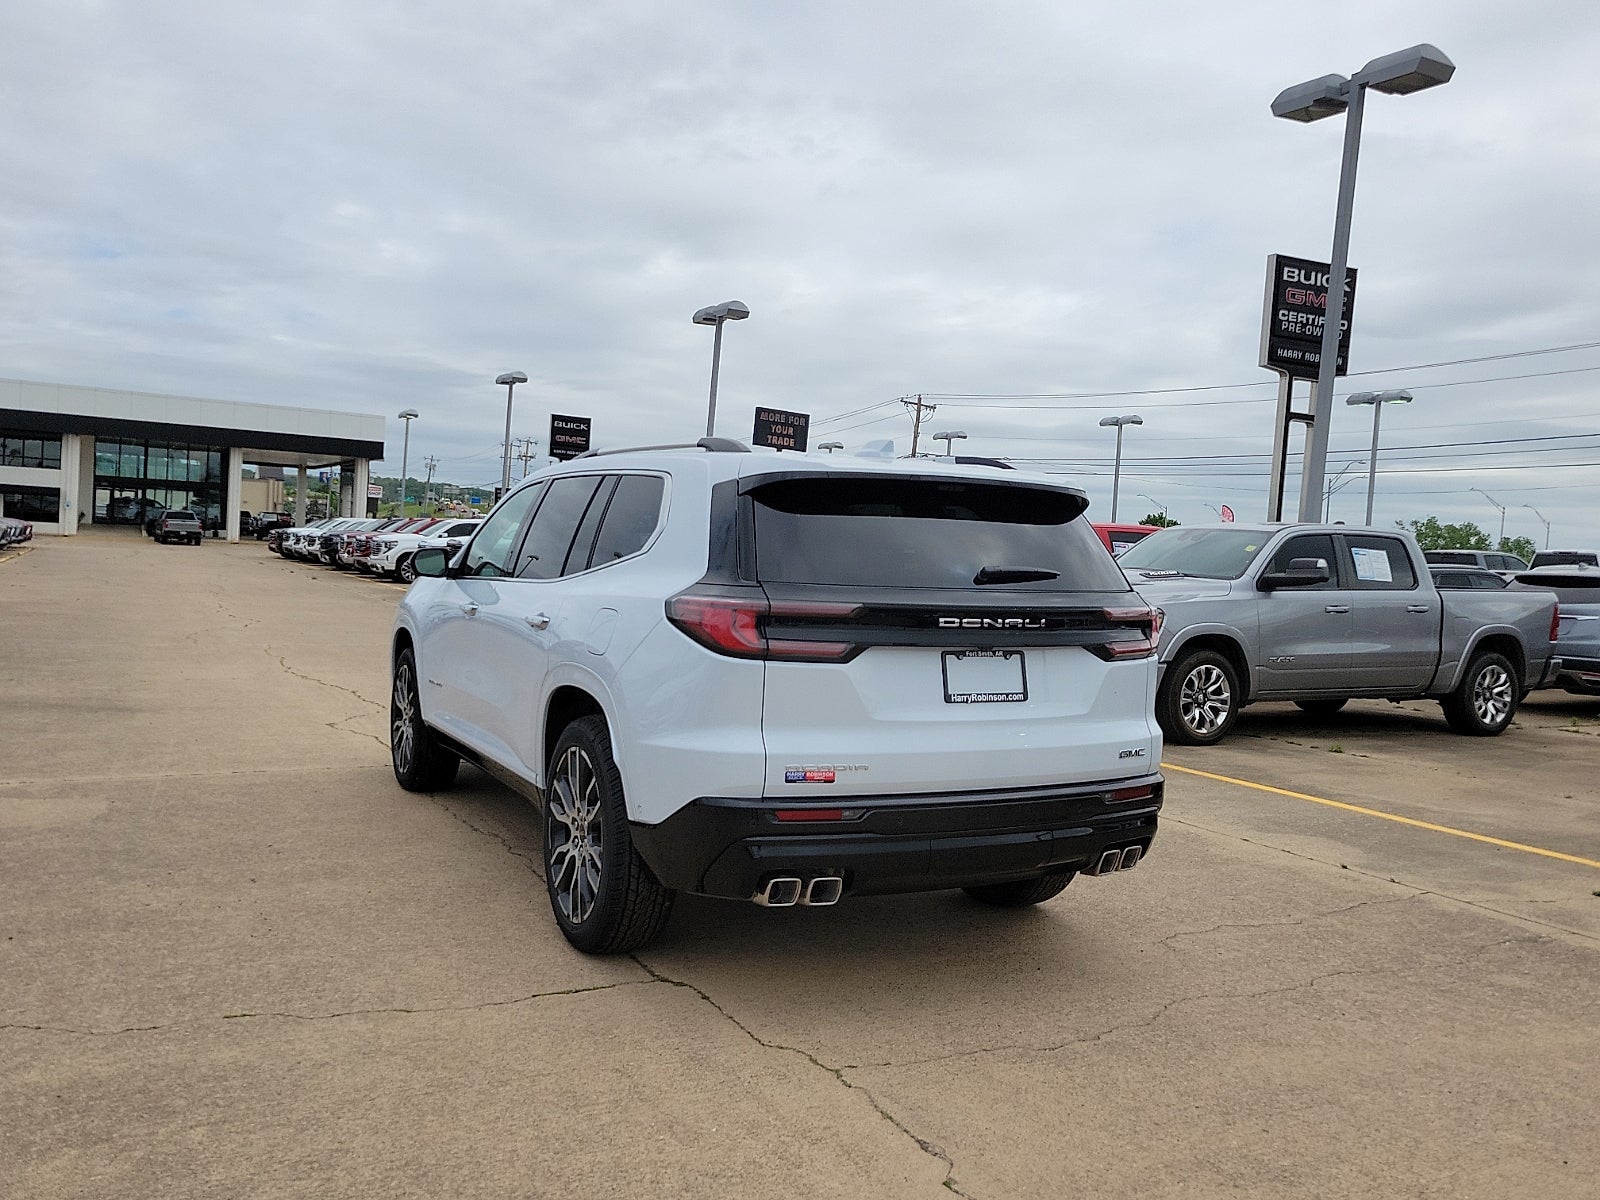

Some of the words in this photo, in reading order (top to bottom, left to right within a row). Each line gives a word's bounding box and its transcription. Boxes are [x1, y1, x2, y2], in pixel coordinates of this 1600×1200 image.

[1278, 308, 1349, 332] CERTIFD
[1281, 320, 1343, 340] PRE-OWD
[1277, 347, 1303, 360] HARRY
[1304, 352, 1343, 365] ROBN
[760, 411, 786, 422] MORE
[788, 415, 806, 425] FOR
[554, 420, 588, 430] BUICK
[771, 424, 794, 435] YOUR
[555, 434, 587, 444] GMC
[767, 434, 795, 447] TRADE
[938, 617, 1046, 628] DENALI
[951, 693, 1024, 703] HarryRobinson.com
[1119, 748, 1145, 758] GMC
